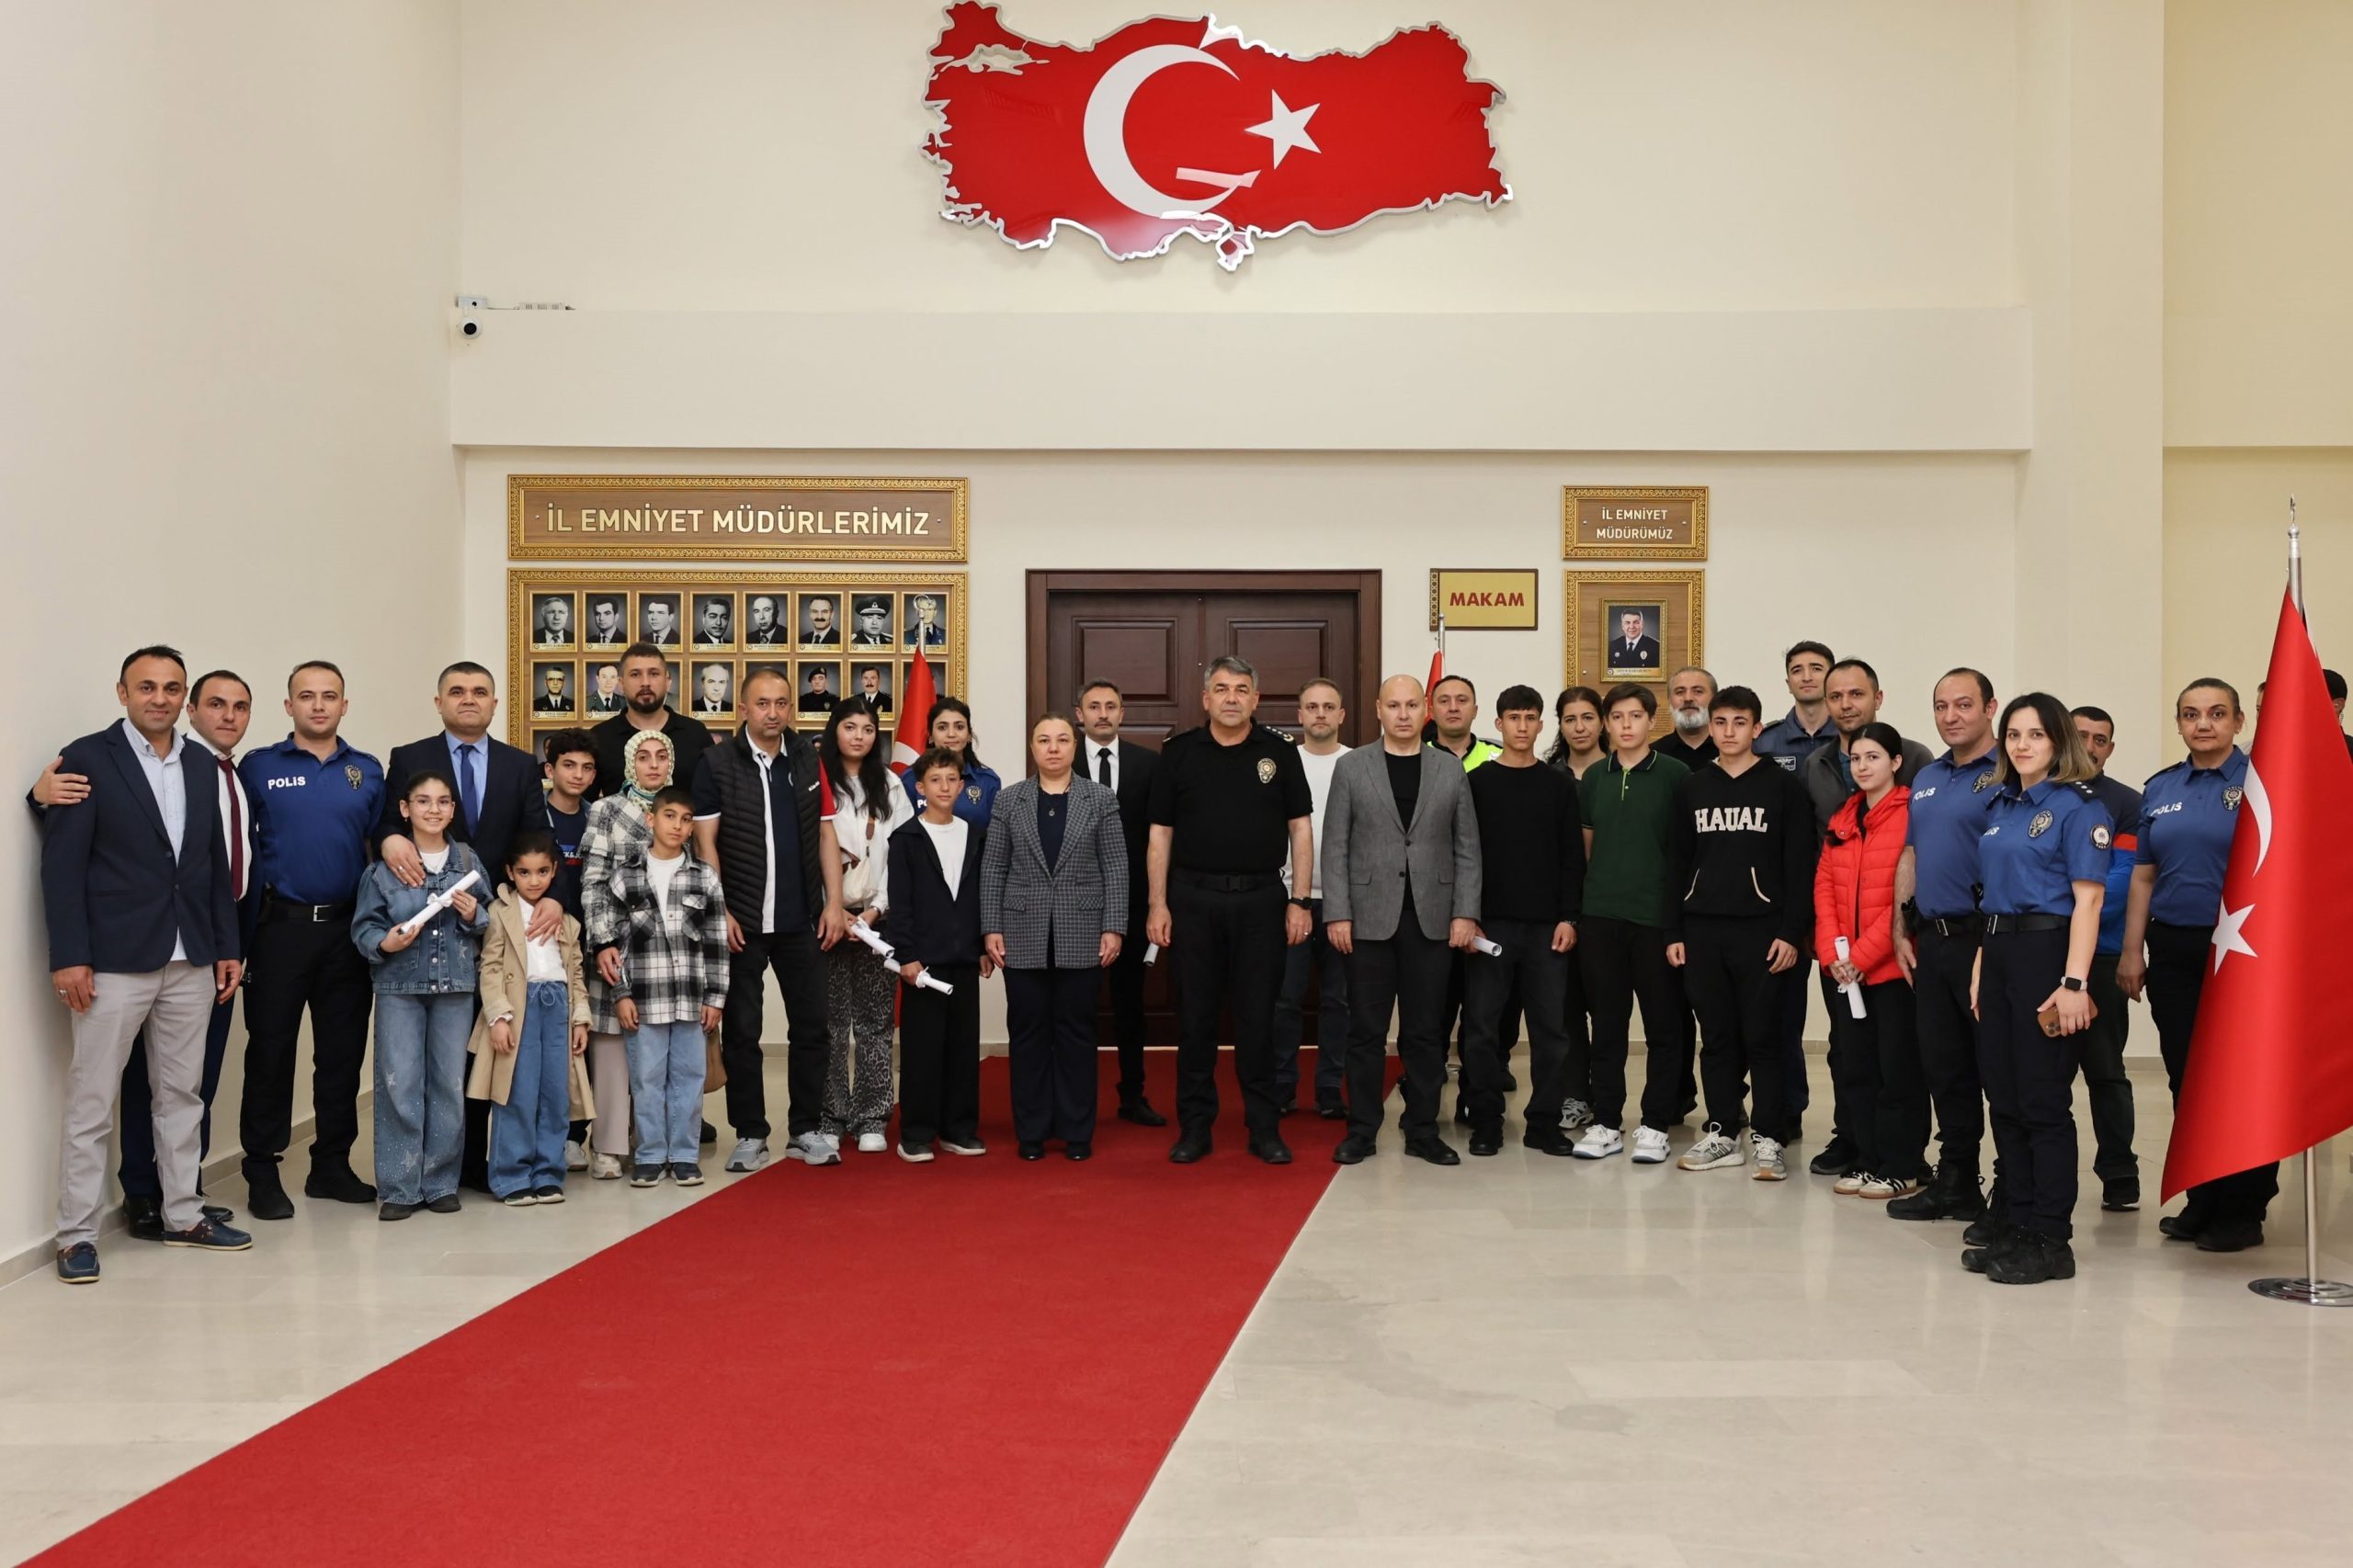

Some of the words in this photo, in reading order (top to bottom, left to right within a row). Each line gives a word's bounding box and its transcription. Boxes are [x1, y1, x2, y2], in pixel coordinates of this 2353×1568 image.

[548, 502, 573, 532] İL
[581, 503, 704, 532] EMNİYET
[712, 504, 929, 535] MÜDÜRLERİMİZ
[1602, 506, 1613, 520] İL
[1616, 507, 1668, 520] EMNİYET
[1597, 526, 1673, 540] MÜDÜRÜMÜZ
[1449, 592, 1525, 607] MAKAM
[1695, 806, 1768, 834] HAUAL
